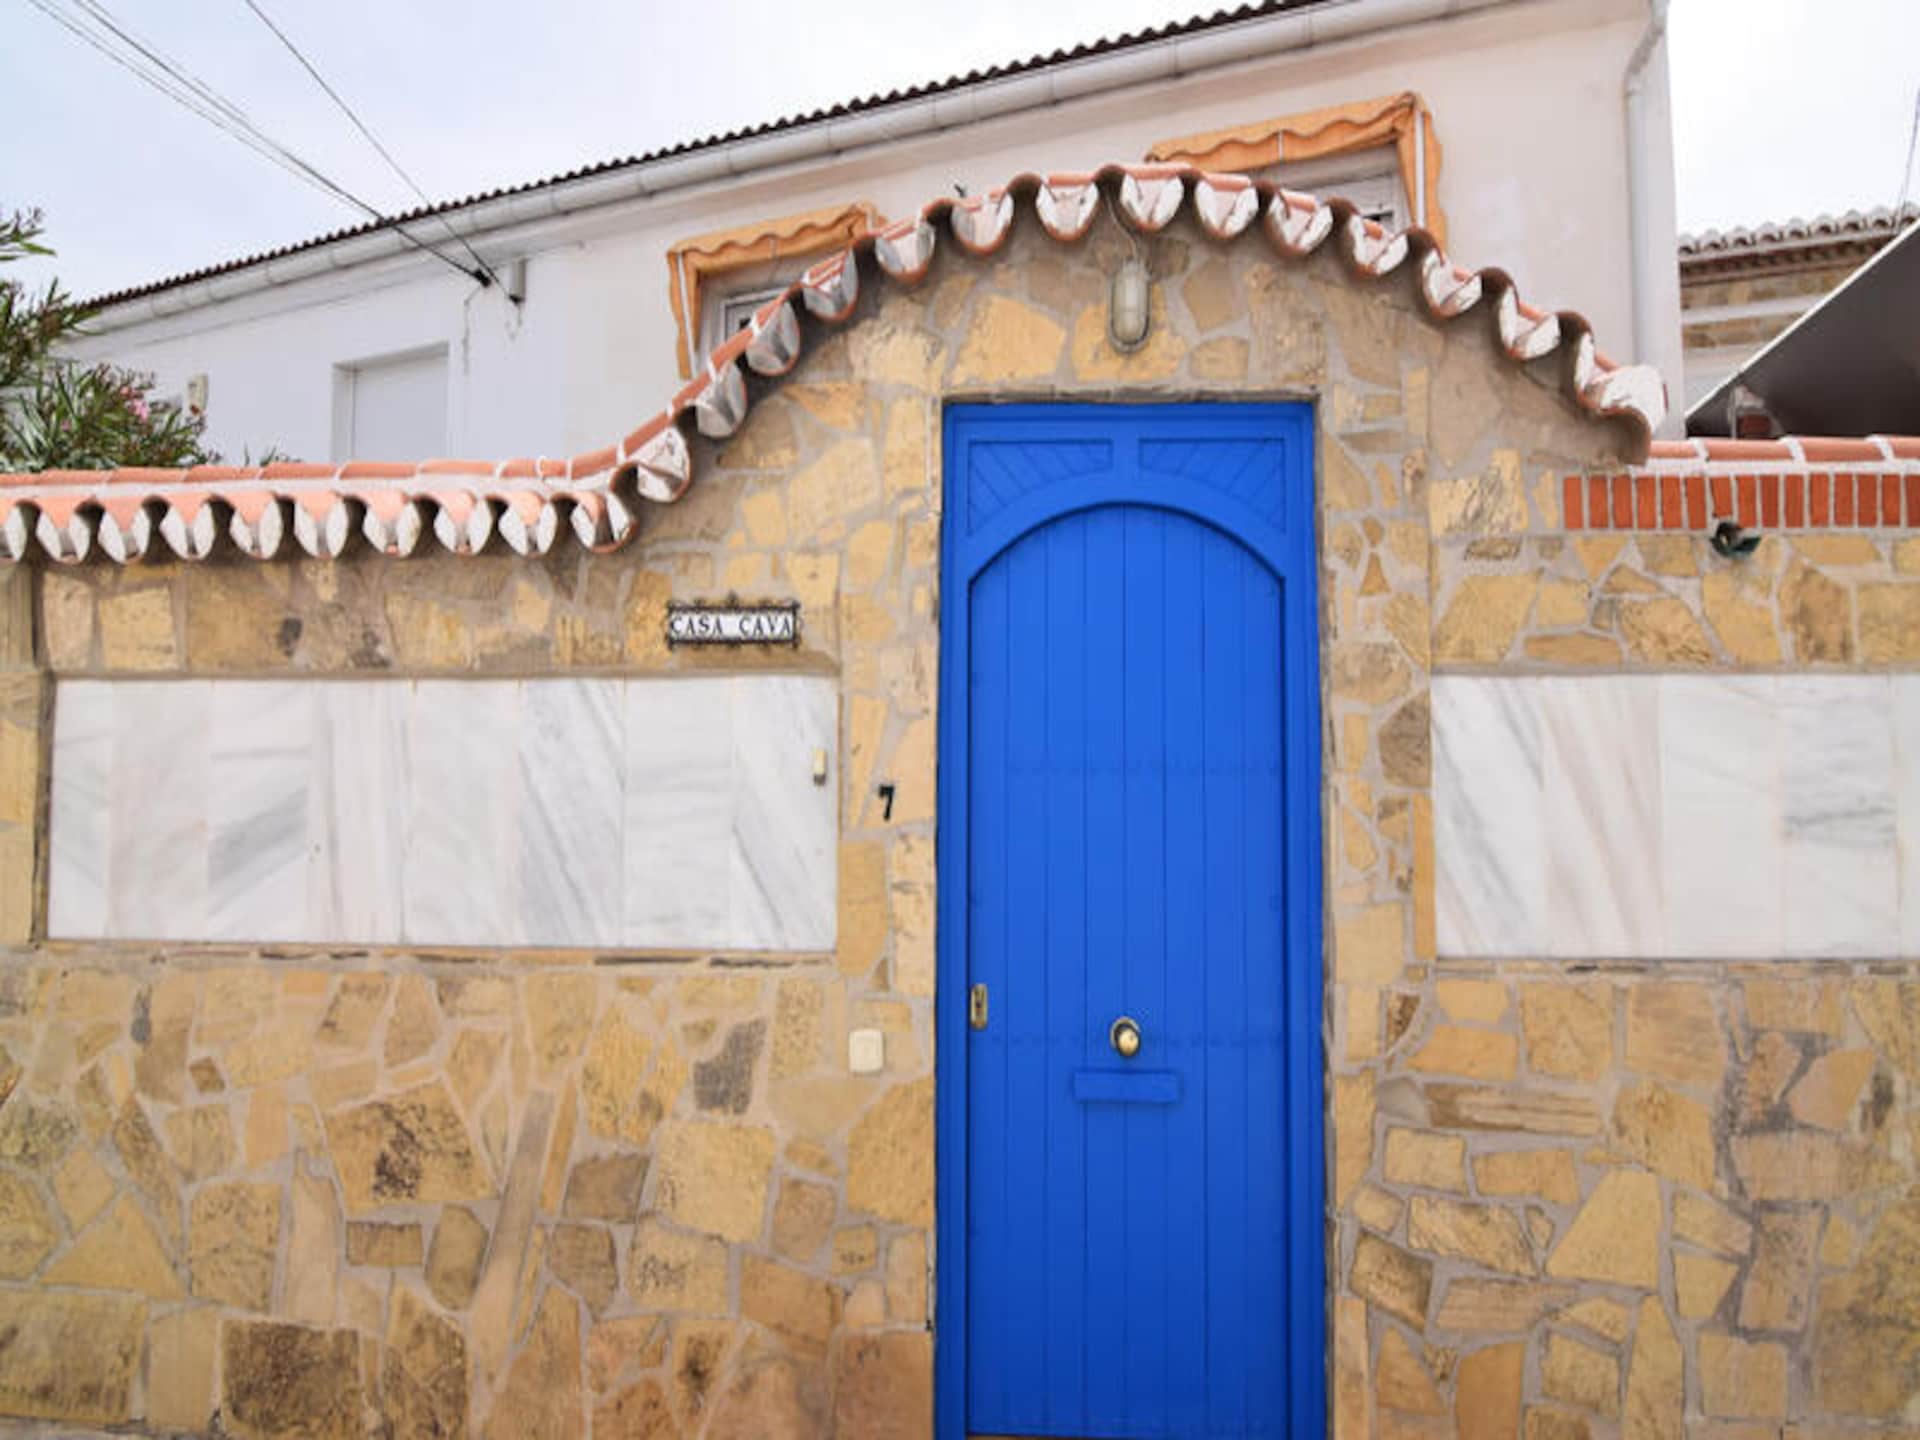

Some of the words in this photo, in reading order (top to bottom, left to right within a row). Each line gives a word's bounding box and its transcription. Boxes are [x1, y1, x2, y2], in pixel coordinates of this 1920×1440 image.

[671, 614, 723, 635] CASA
[738, 614, 791, 635] CAVA
[879, 784, 895, 821] 7
